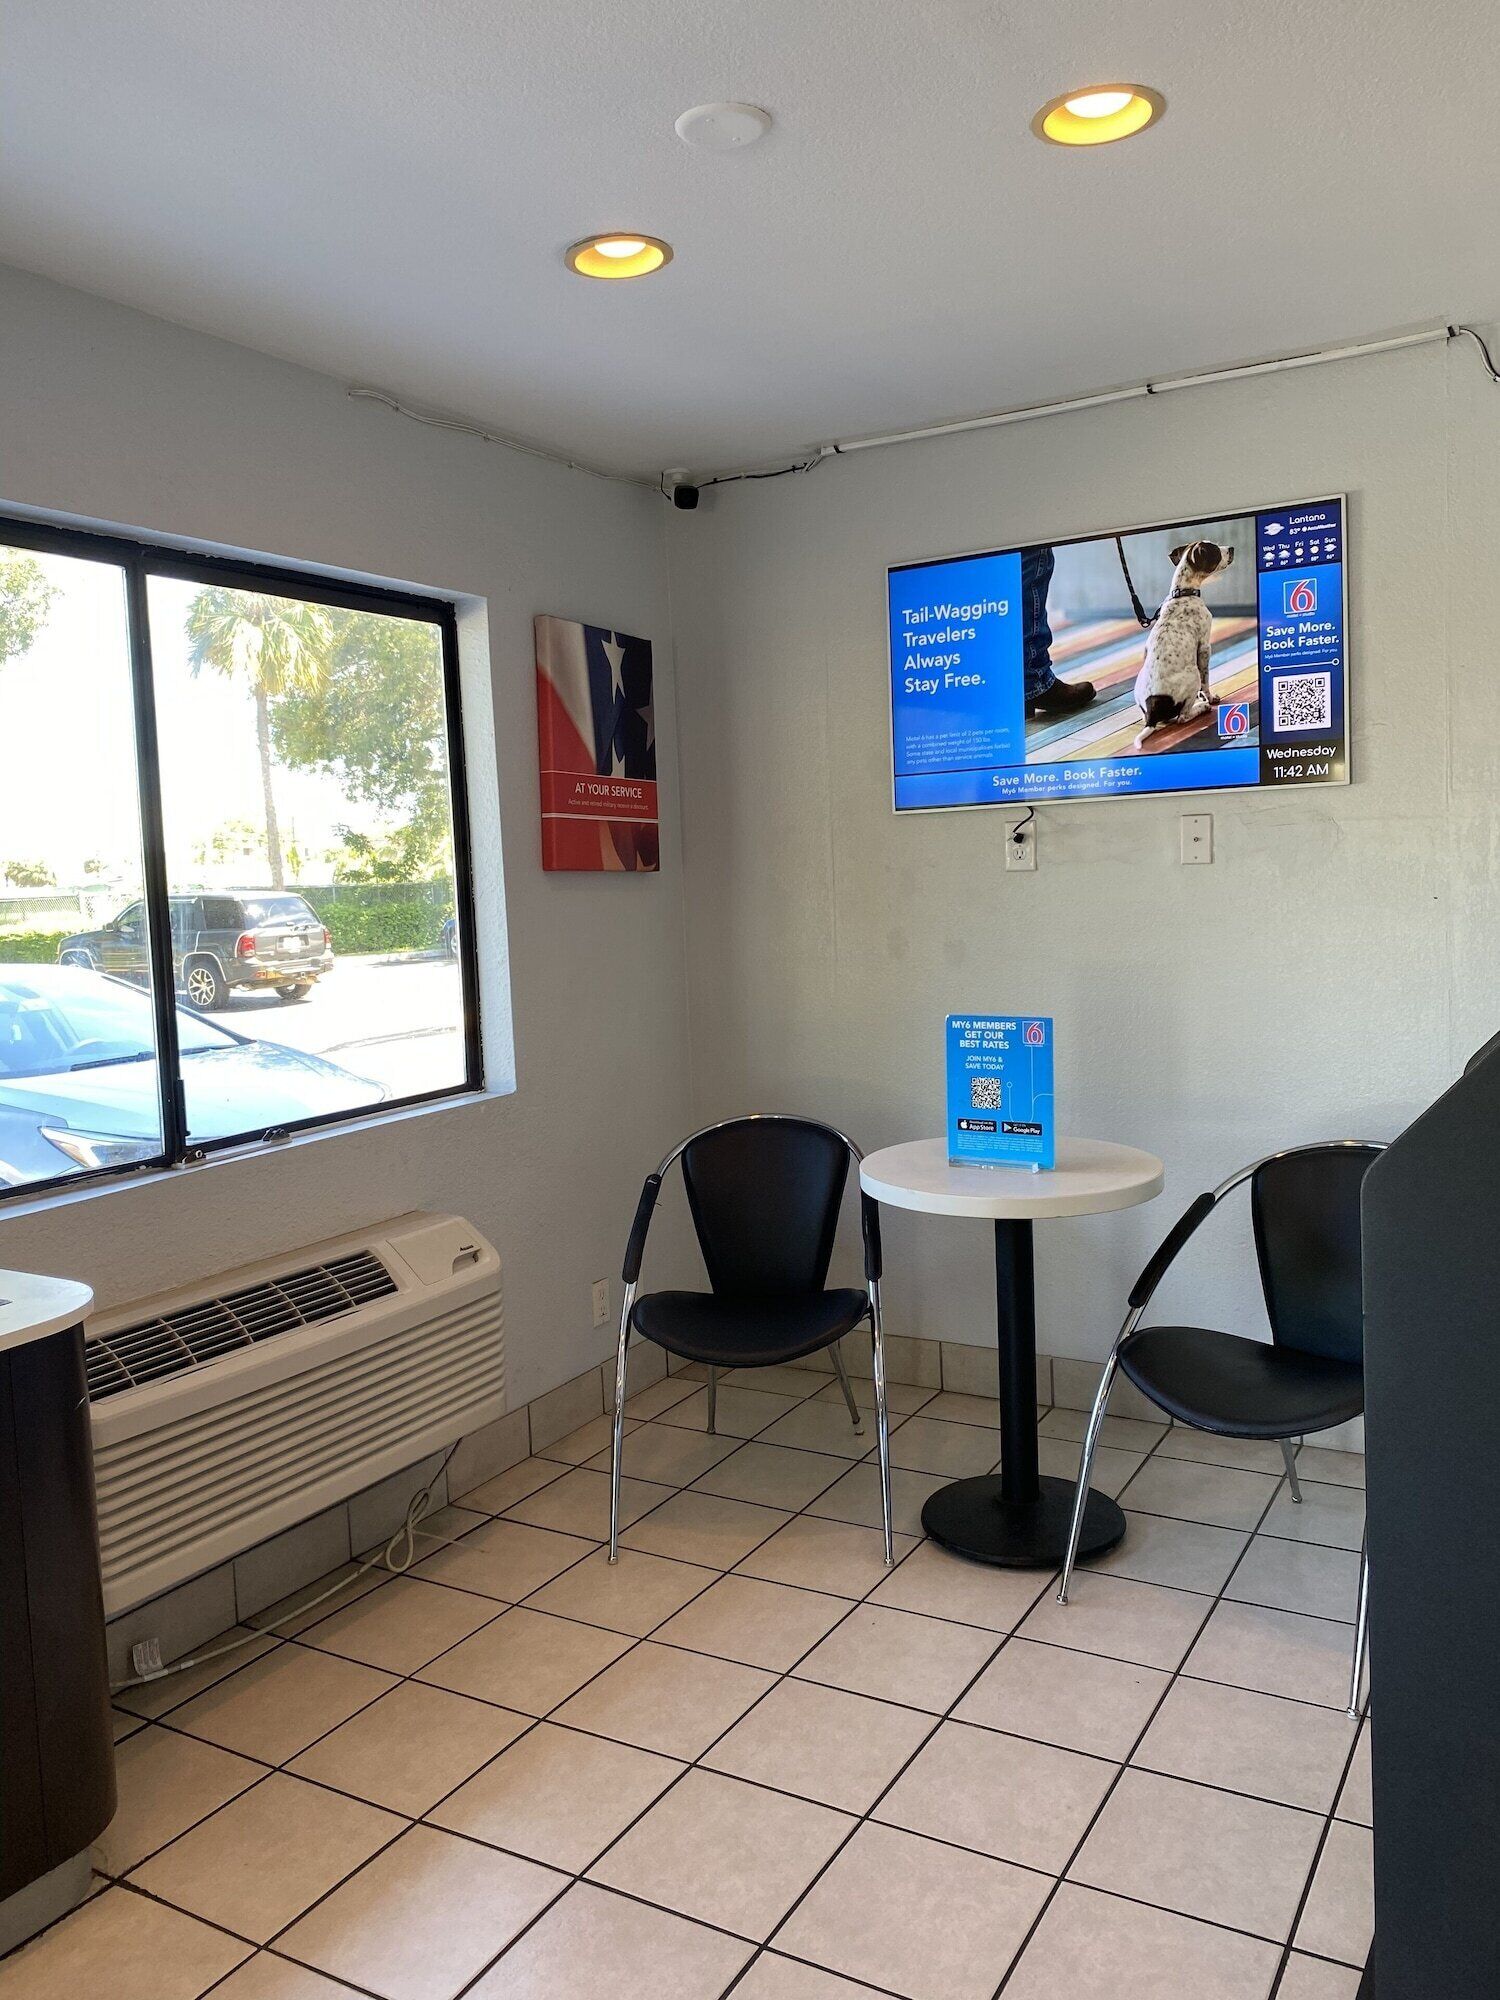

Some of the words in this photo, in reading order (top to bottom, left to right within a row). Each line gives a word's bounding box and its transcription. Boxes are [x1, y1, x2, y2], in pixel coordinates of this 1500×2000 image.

[1290, 580, 1315, 612] 6
[902, 598, 1009, 625] Tail-Wagging
[903, 626, 976, 648] Travelers
[1266, 626, 1295, 637] Save
[1299, 622, 1336, 633] More.
[1263, 637, 1295, 651] Book
[1298, 635, 1340, 647] Faster.
[903, 653, 961, 671] Always
[904, 677, 940, 695] Stay
[944, 672, 986, 689] Free.
[1224, 703, 1247, 735] 6
[1267, 745, 1336, 759] Wednesday
[992, 775, 1019, 786] Save
[1024, 773, 1059, 784] More.
[1064, 768, 1095, 781] Book
[1099, 766, 1142, 778] Faster.
[1273, 765, 1303, 778] 11:42
[1306, 763, 1329, 777] AM
[575, 782, 586, 793] AT
[588, 784, 609, 796] YOUR
[611, 785, 642, 799] SERVICE
[1018, 785, 1046, 794] Member
[1047, 783, 1066, 793] perks
[952, 1020, 971, 1029] MY6
[973, 1021, 1016, 1030] MEMBERS
[1026, 1022, 1043, 1044] 6
[964, 1031, 982, 1039] GET
[984, 1031, 1004, 1039] OUR
[960, 1040, 980, 1048] BEST
[982, 1041, 1009, 1049] RATES
[969, 1123, 980, 1131] App
[1013, 1126, 1029, 1134] Google
